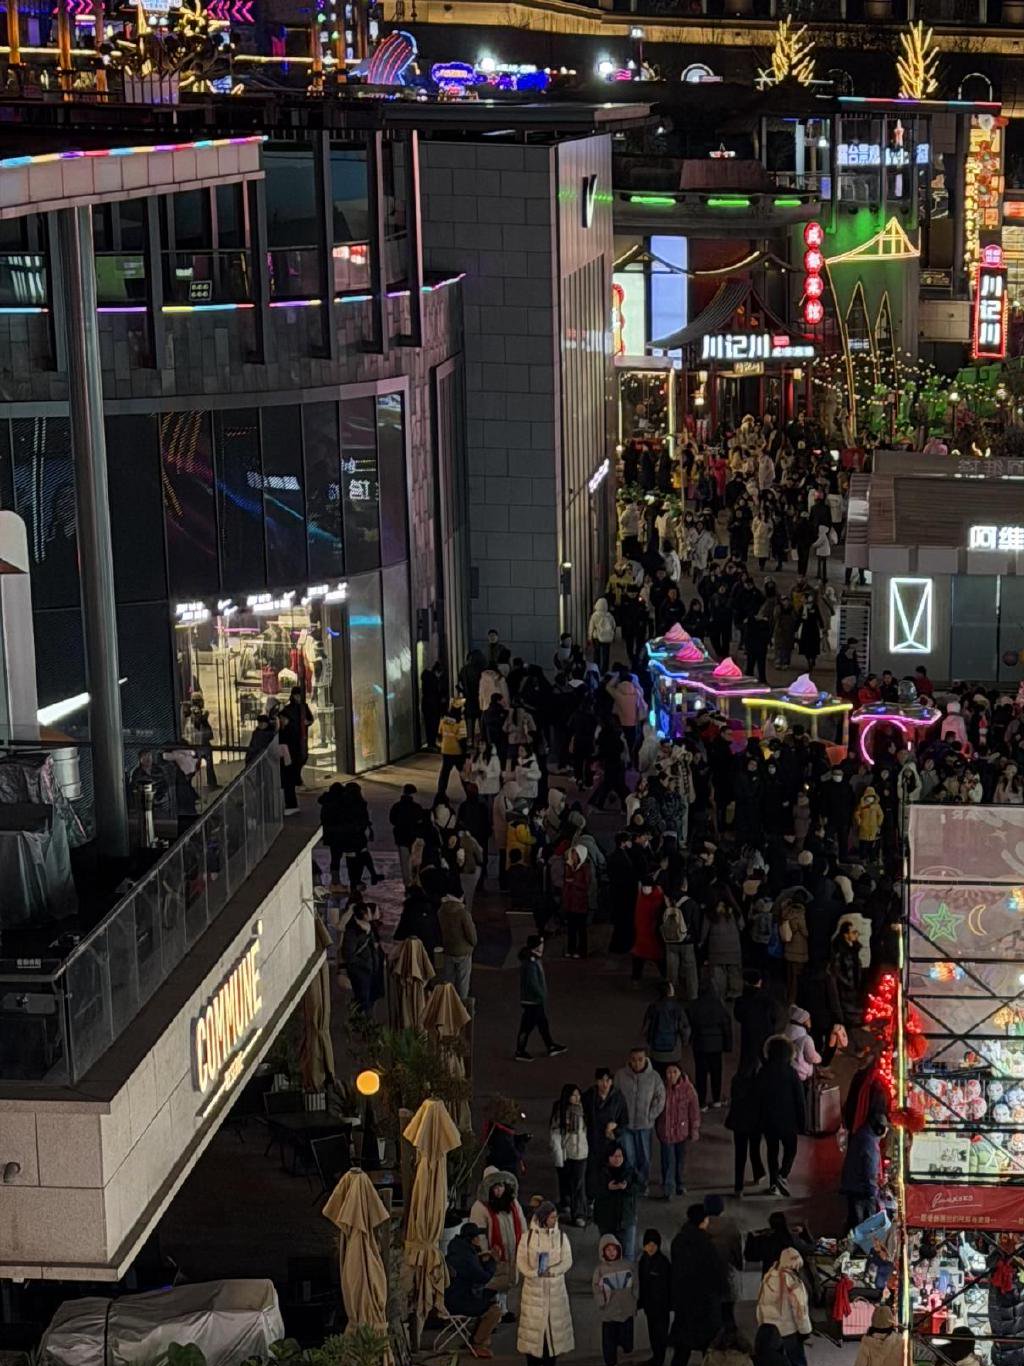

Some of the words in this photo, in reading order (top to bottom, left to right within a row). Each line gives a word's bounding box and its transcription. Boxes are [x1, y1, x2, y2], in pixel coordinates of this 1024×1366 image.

[980, 275, 1003, 345] 川记川
[702, 334, 770, 359] 川记川
[197, 938, 262, 1078] COMMUNE
